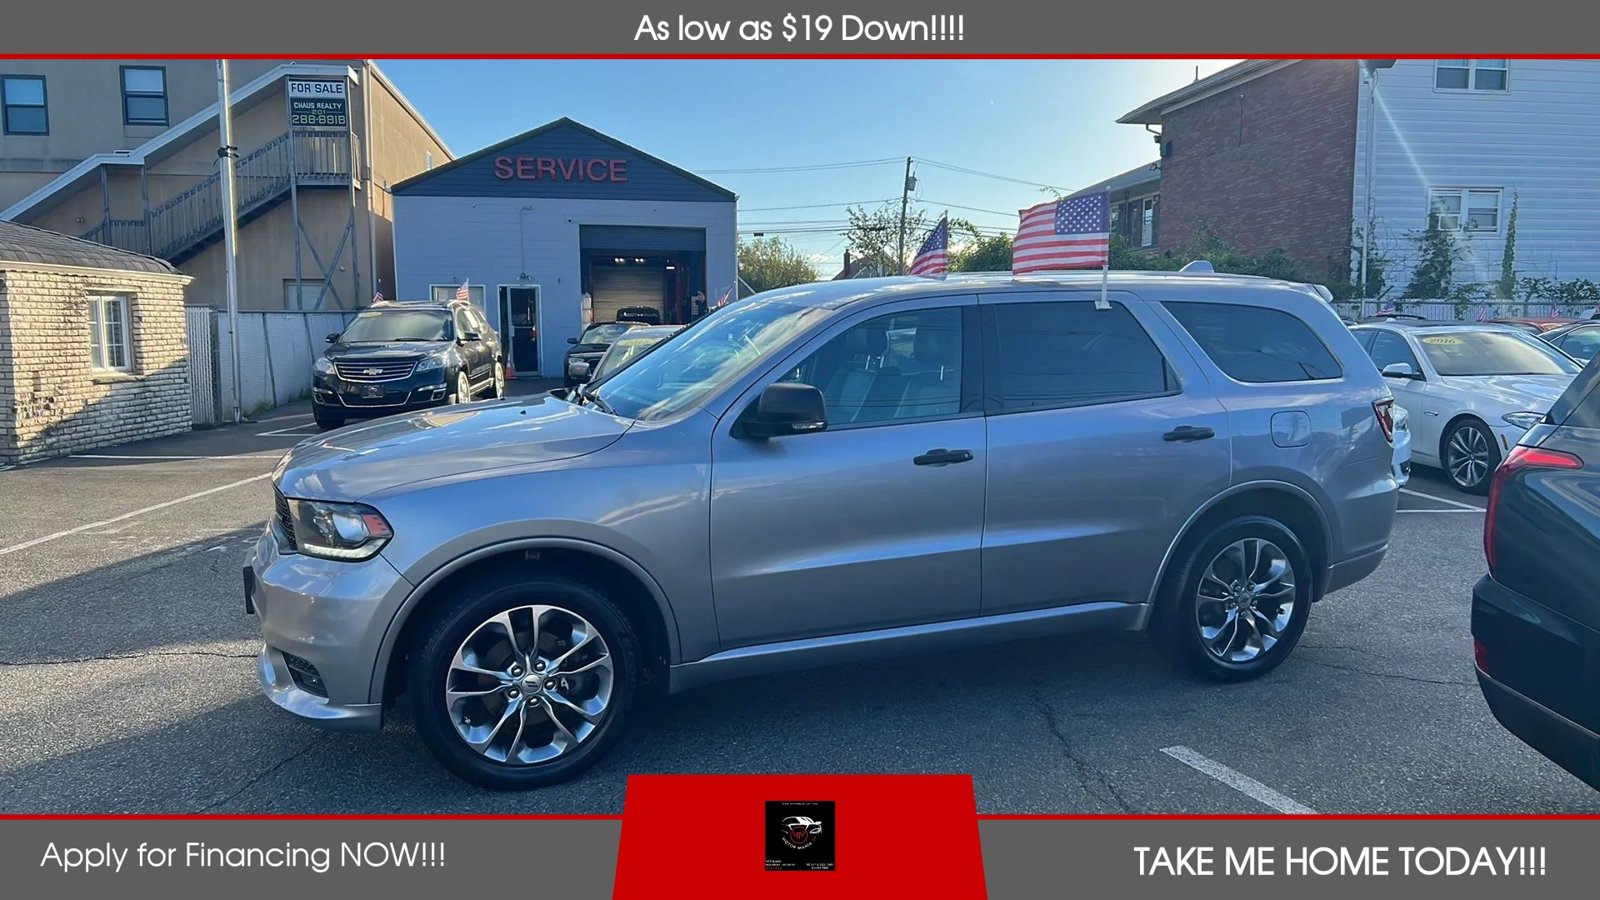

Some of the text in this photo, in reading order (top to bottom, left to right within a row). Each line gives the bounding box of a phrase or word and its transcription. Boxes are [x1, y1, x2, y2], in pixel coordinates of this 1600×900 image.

[291, 82, 343, 94] FOR SALE
[316, 102, 343, 110] REALTY
[494, 156, 628, 182] SERVICE
